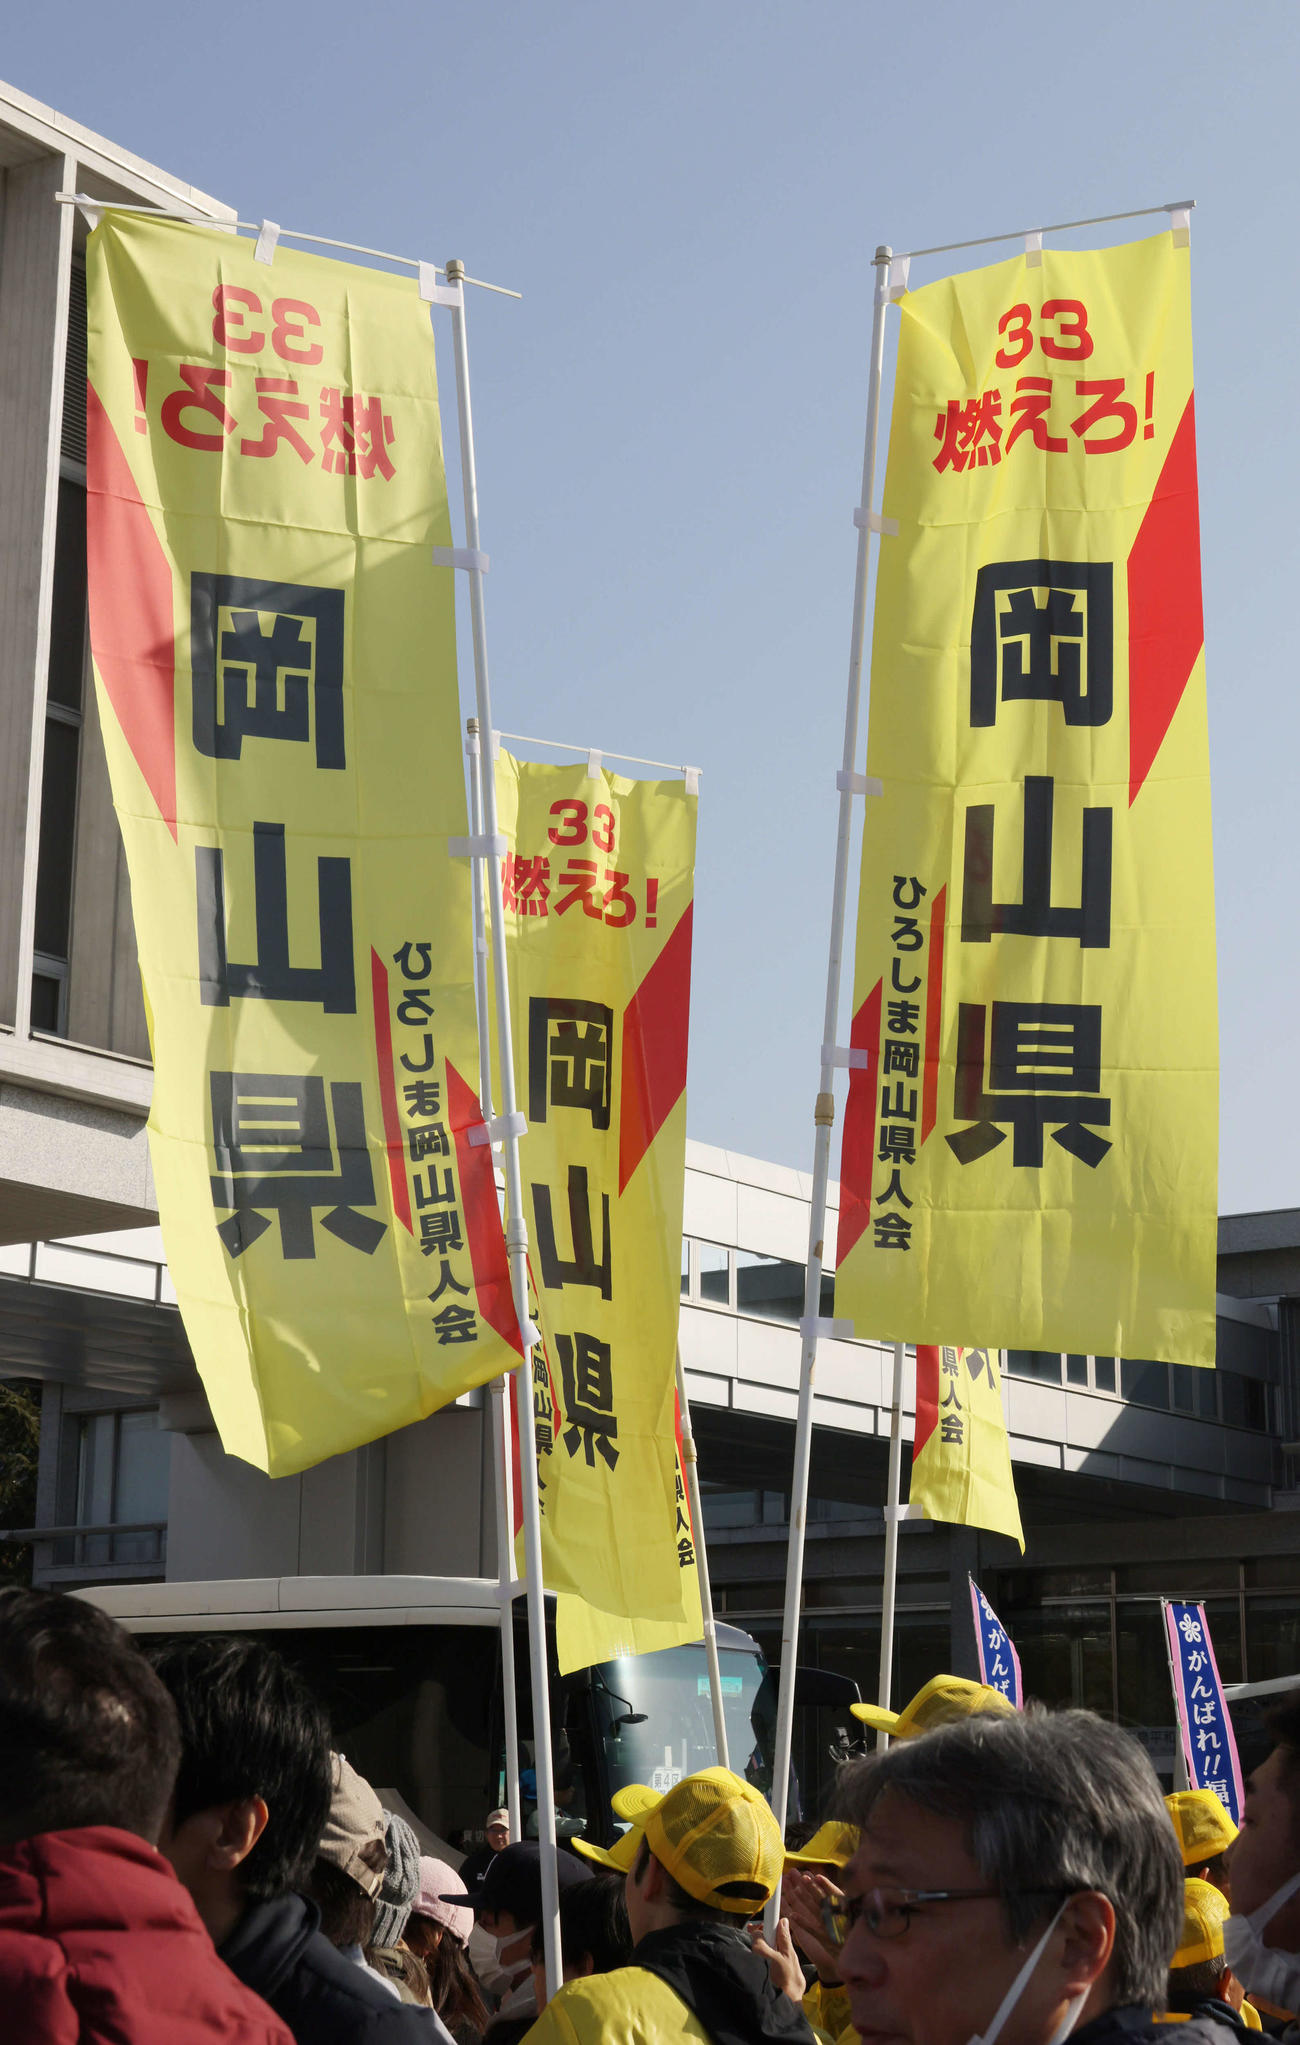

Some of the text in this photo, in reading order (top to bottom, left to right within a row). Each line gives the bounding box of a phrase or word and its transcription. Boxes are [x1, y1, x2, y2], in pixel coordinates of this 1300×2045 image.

[995, 299, 1095, 369] 33
[932, 370, 1156, 474] 燃えろ!
[500, 851, 659, 928] 燃えろ!
[547, 799, 616, 853] 33
[944, 558, 1113, 1169] 岡山県
[873, 874, 927, 1252] ひろしま岡山県人会
[529, 996, 620, 1472] 岡山県
[1187, 1650, 1233, 1818] がんばれ!!福
